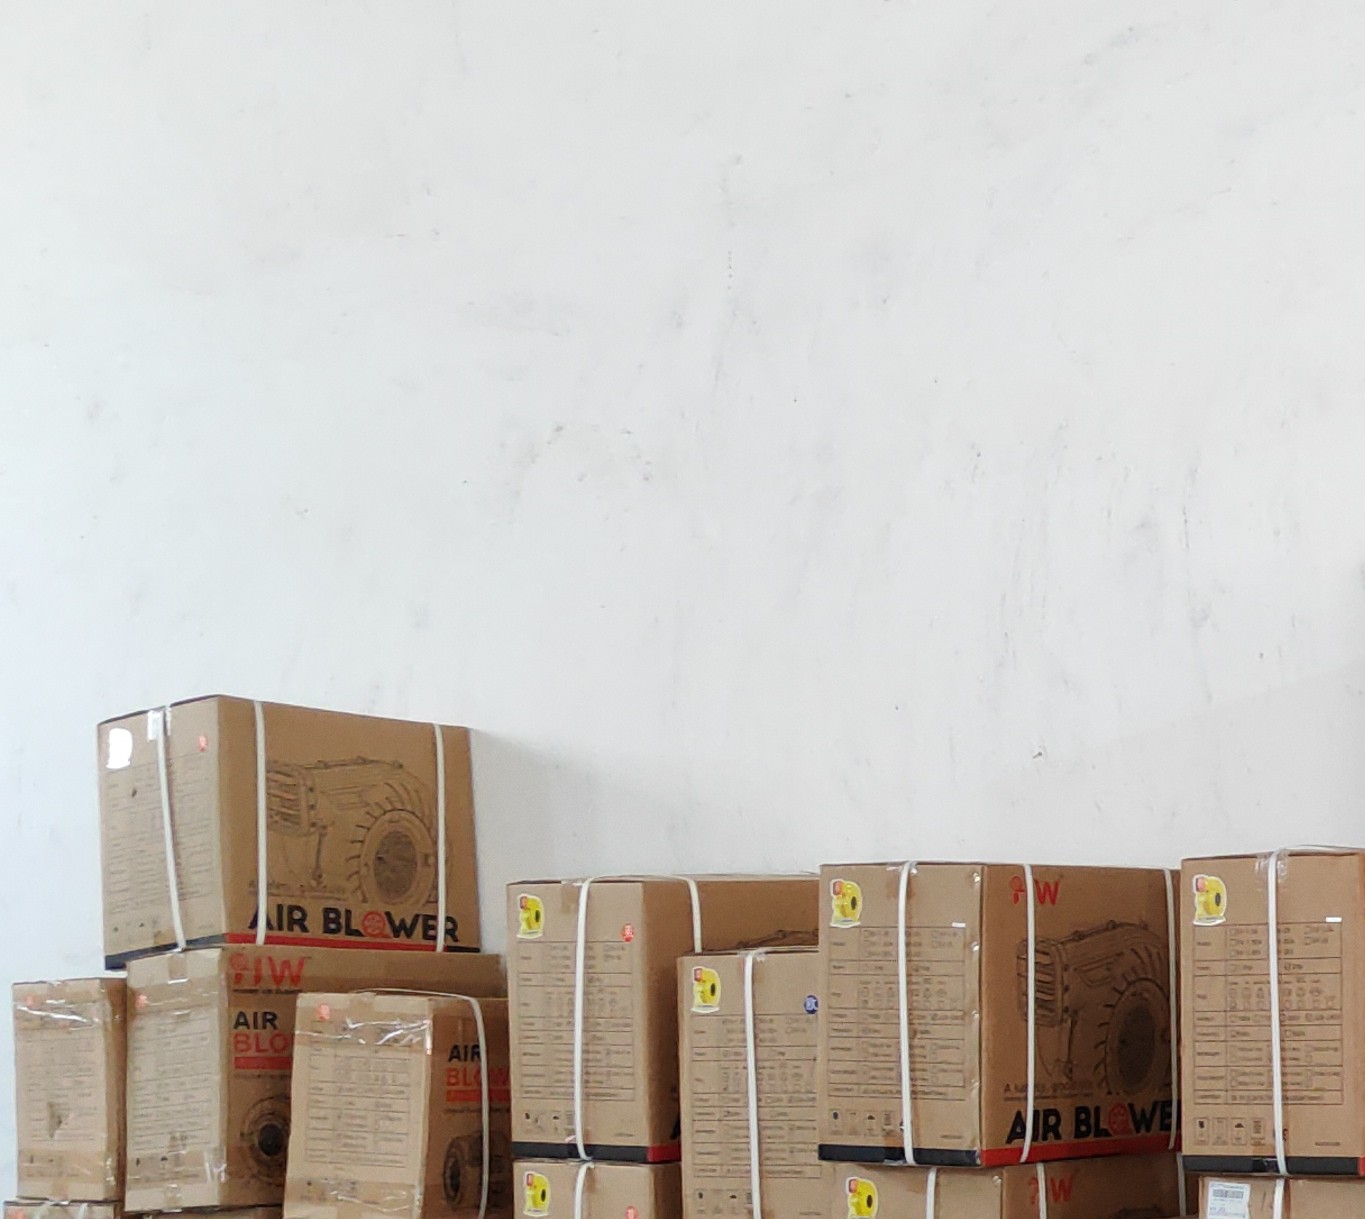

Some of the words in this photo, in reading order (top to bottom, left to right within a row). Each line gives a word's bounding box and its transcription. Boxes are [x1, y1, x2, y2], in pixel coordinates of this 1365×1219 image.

[248, 903, 309, 934] AIR
[321, 906, 460, 944] BLOWER
[233, 1010, 279, 1031] AIR
[1006, 1106, 1062, 1145] AIR
